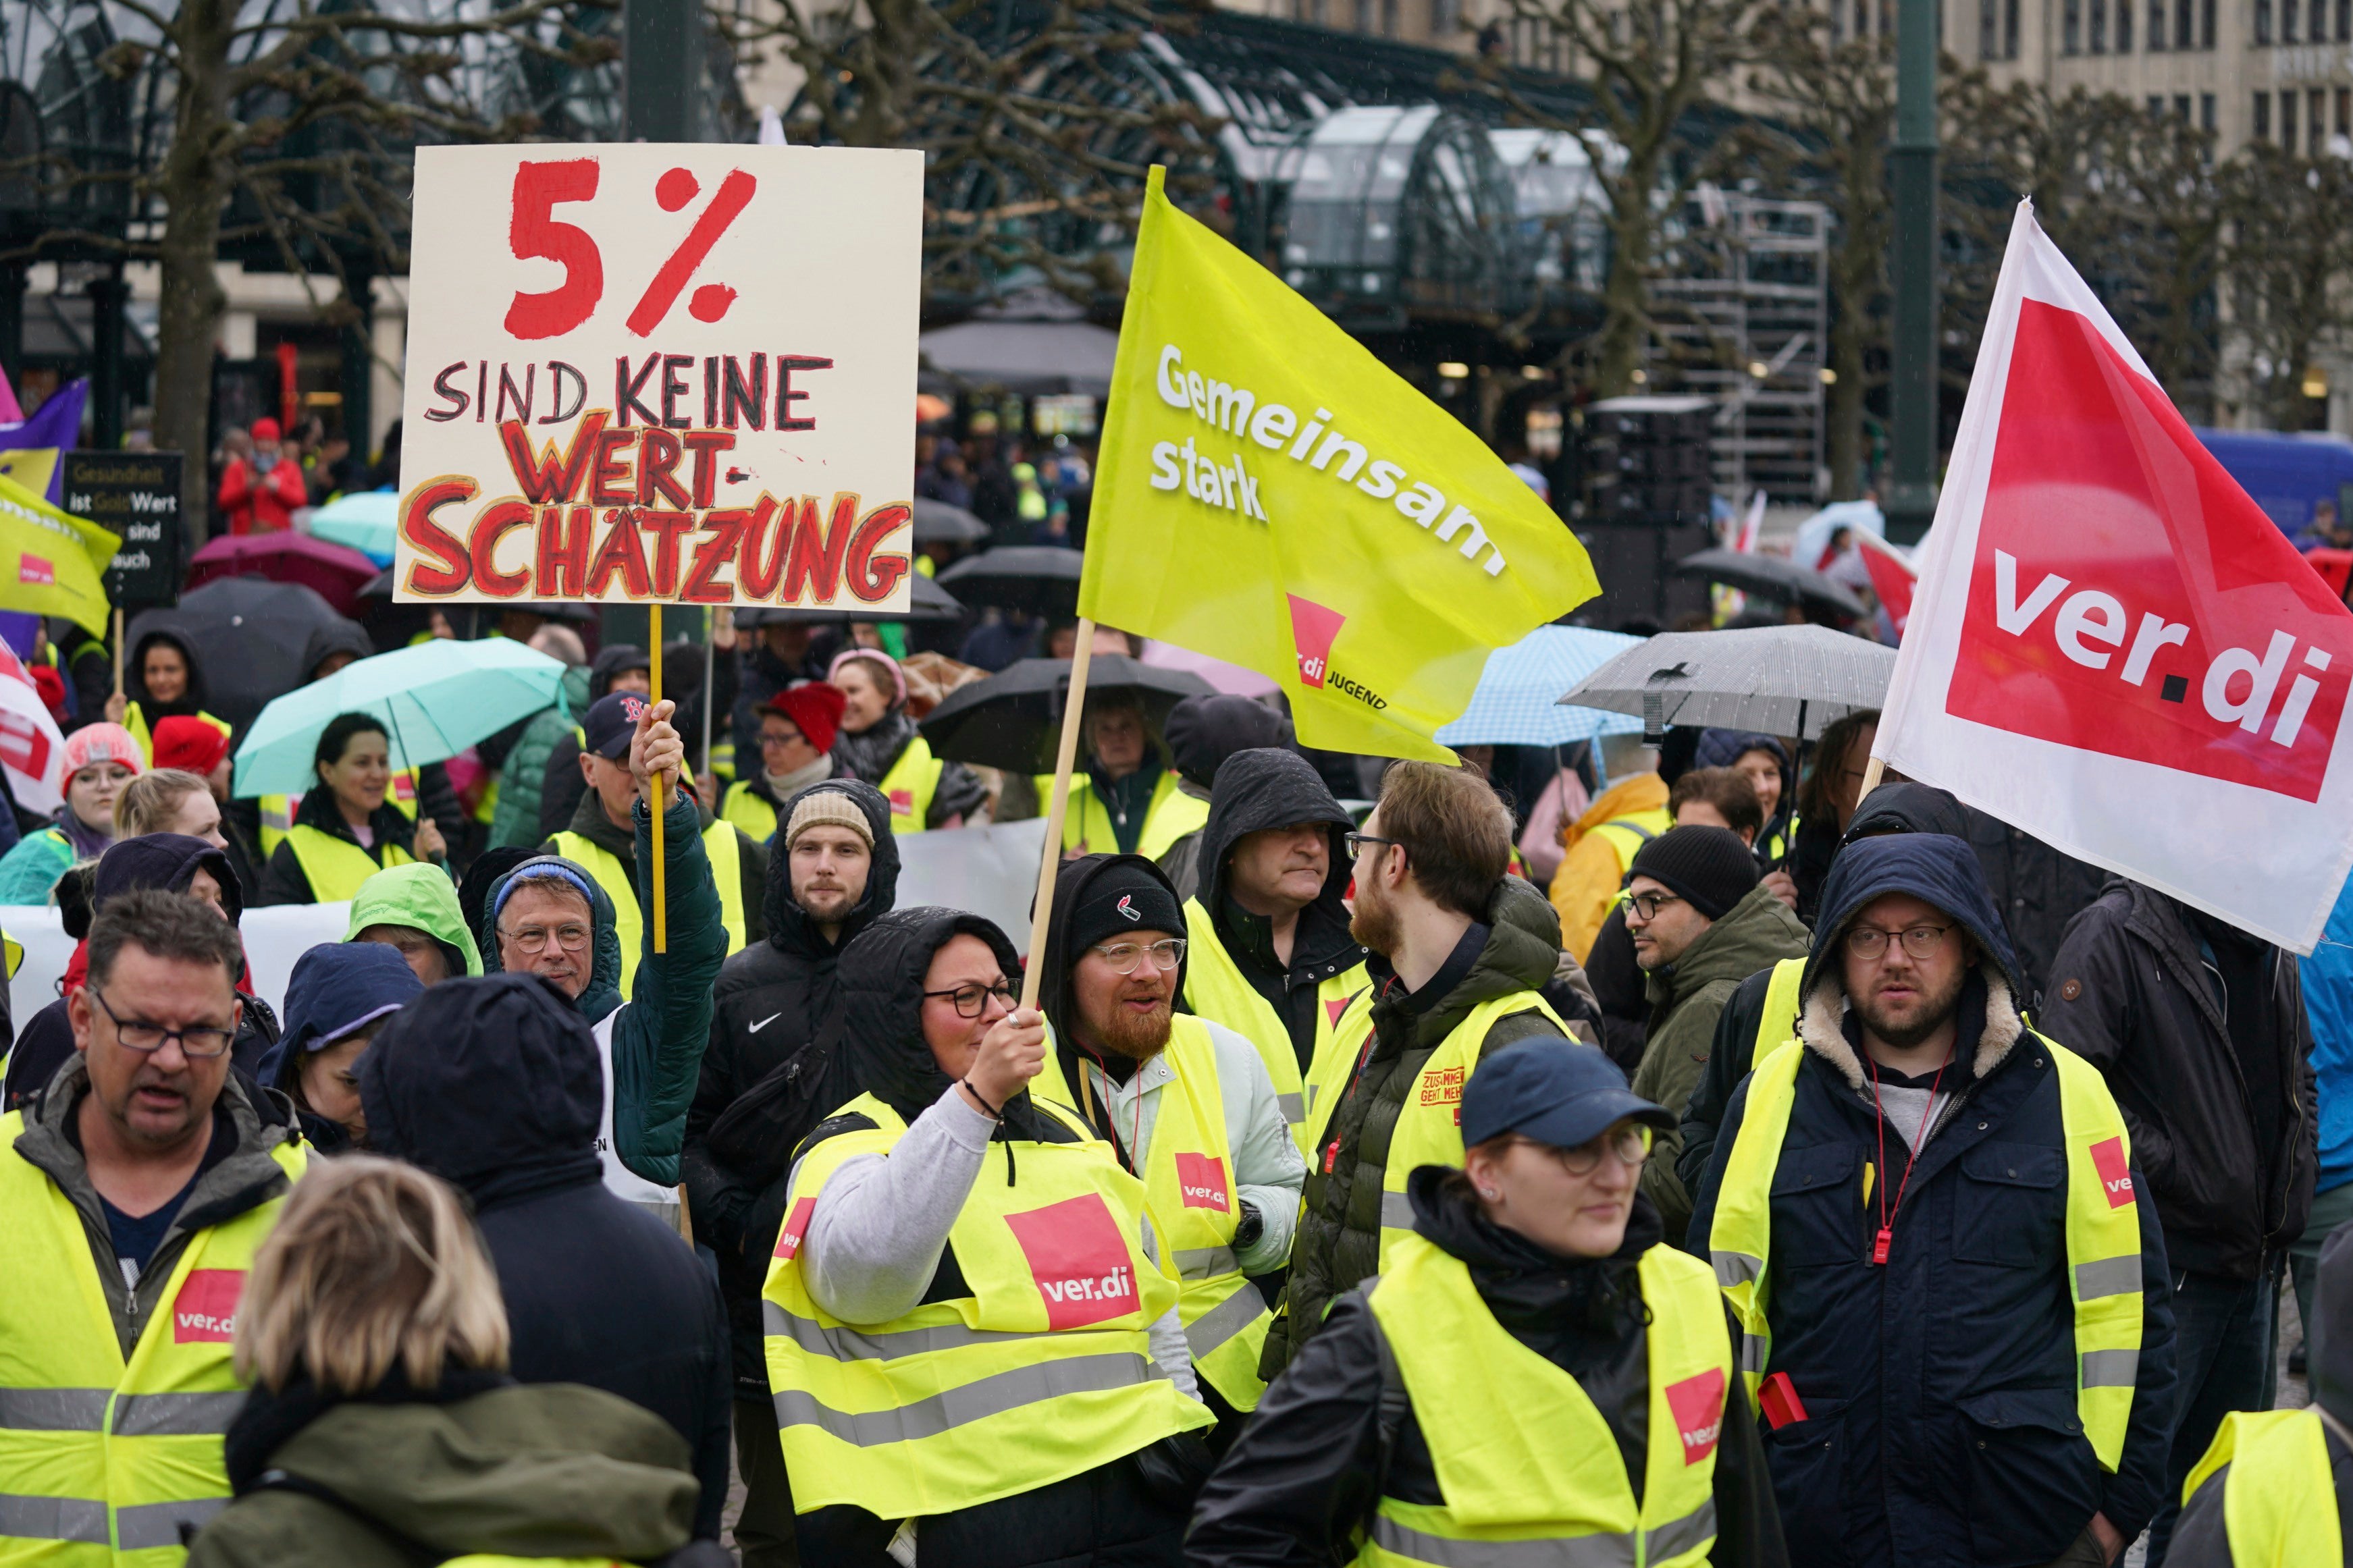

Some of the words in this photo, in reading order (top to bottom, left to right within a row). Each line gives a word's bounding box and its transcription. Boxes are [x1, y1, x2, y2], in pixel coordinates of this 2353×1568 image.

[504, 155, 604, 340] 5
[626, 167, 757, 337] %
[424, 360, 587, 425] SIND
[616, 352, 834, 431] KEINE
[496, 408, 749, 511] WERT-
[1157, 344, 1506, 577] Gemeinsam
[1150, 436, 1269, 524] stark
[70, 491, 92, 512] ist
[130, 491, 177, 513] Wert
[128, 520, 161, 541] sind
[398, 475, 911, 605] SCHÄTZUNG
[111, 549, 151, 568] auch
[1994, 547, 2333, 749] ver.di
[620, 697, 644, 722] B
[1327, 671, 1387, 710] JUGEND
[1421, 1088, 1441, 1102] GEHT
[1184, 1185, 1225, 1206] ver.di
[1042, 1266, 1130, 1302] ver.di
